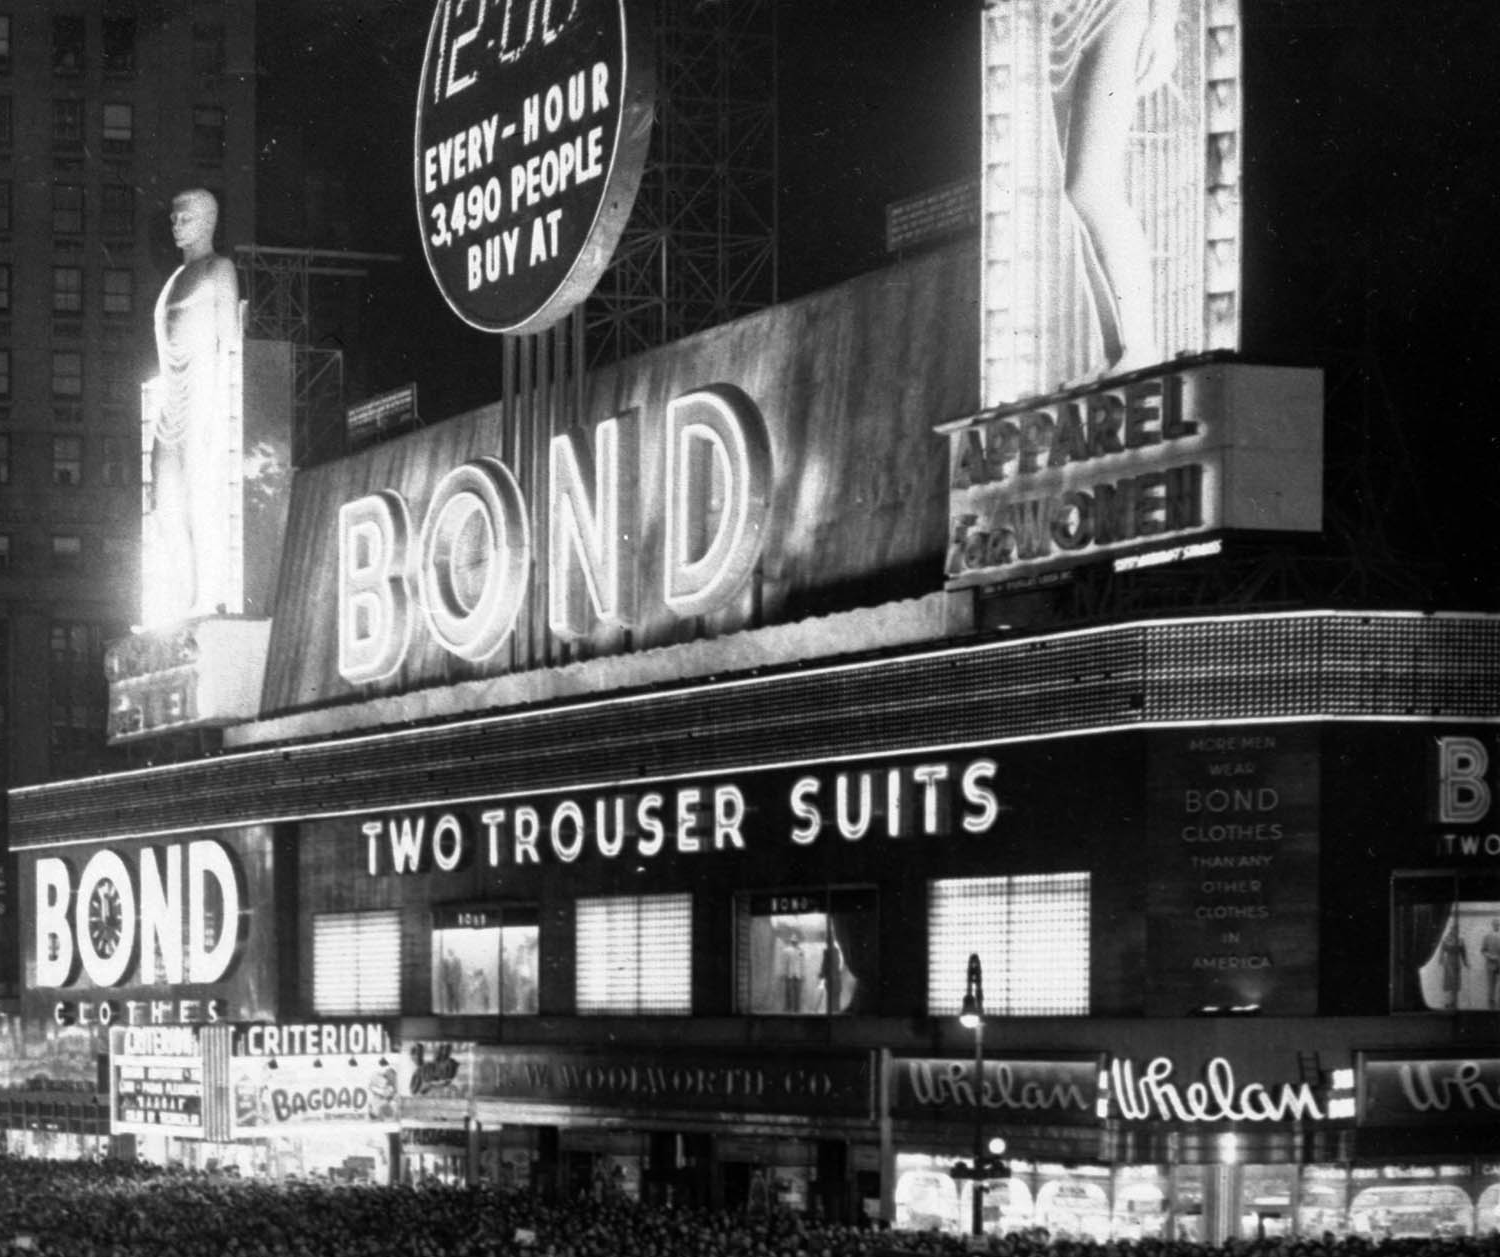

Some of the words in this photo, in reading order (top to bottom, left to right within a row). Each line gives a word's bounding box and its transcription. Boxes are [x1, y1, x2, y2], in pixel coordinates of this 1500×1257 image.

[430, 176, 502, 248] 3,490
[511, 126, 604, 213] PEOPLE
[467, 225, 517, 292] BUY
[529, 208, 564, 267] AT
[952, 374, 1199, 490] APPAREL
[338, 384, 770, 683] BOND
[361, 814, 462, 875] TWO
[481, 784, 746, 867] TROUSER
[789, 759, 999, 845] SUITS
[1185, 788, 1280, 813] BOND
[1181, 824, 1284, 842] CLOTHES
[36, 839, 240, 988] BOND
[1195, 905, 1270, 920] CLOTHES
[1191, 957, 1273, 970] AMERICA
[54, 1000, 219, 1025] CLOTHES
[248, 1023, 384, 1056] CRITERION
[560, 1063, 765, 1096] WOOLWORTH
[907, 1059, 1095, 1111] Whelan
[1111, 1056, 1328, 1121] Whelan
[1400, 1059, 1500, 1112] Wh
